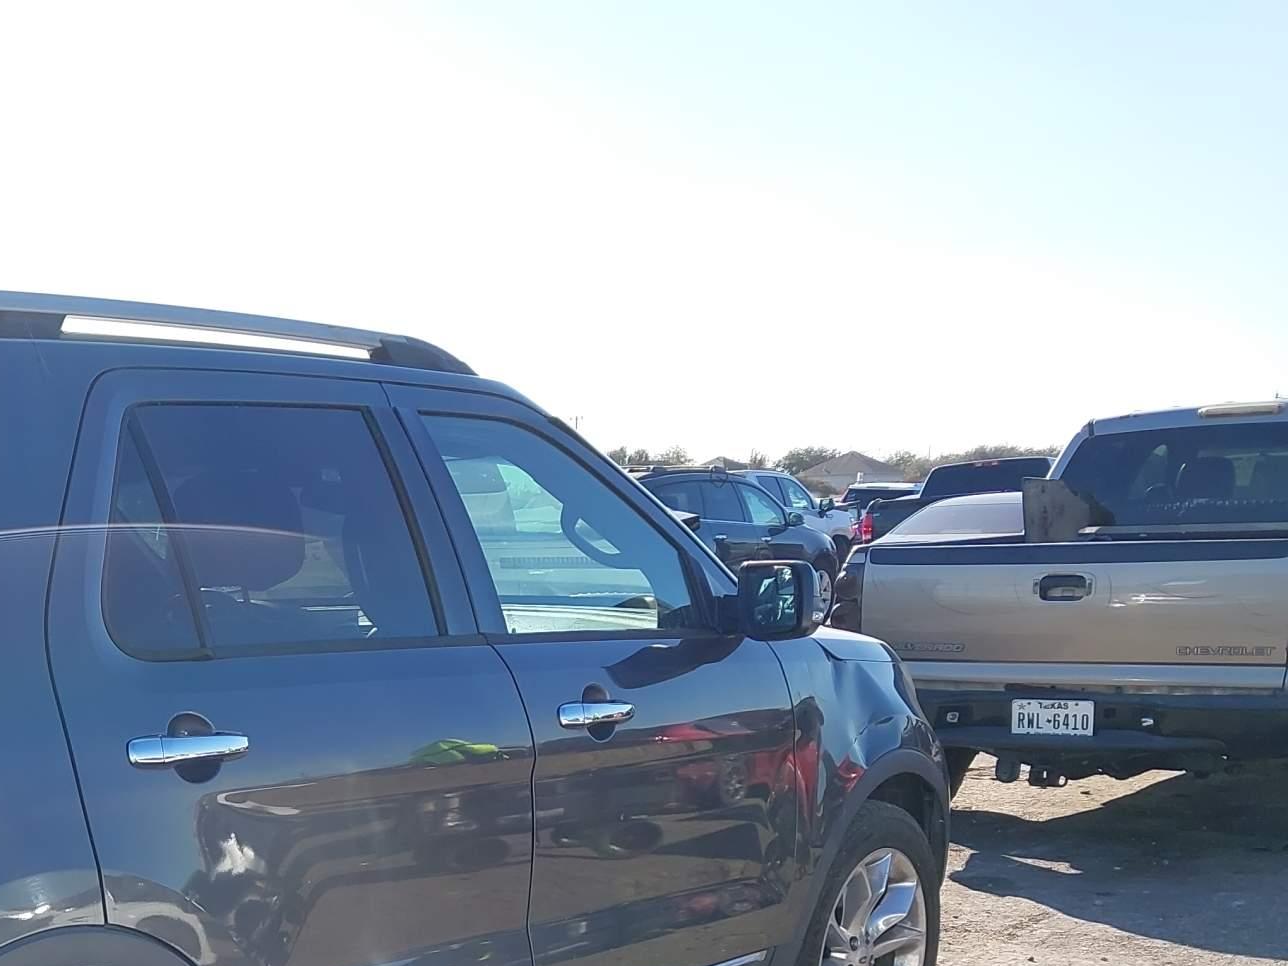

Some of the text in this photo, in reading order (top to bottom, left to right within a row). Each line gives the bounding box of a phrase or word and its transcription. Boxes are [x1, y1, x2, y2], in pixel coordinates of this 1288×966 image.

[1175, 646, 1277, 657] CHEVROLET
[1038, 702, 1069, 710] TEXAS
[1017, 712, 1089, 731] RWL 6410
